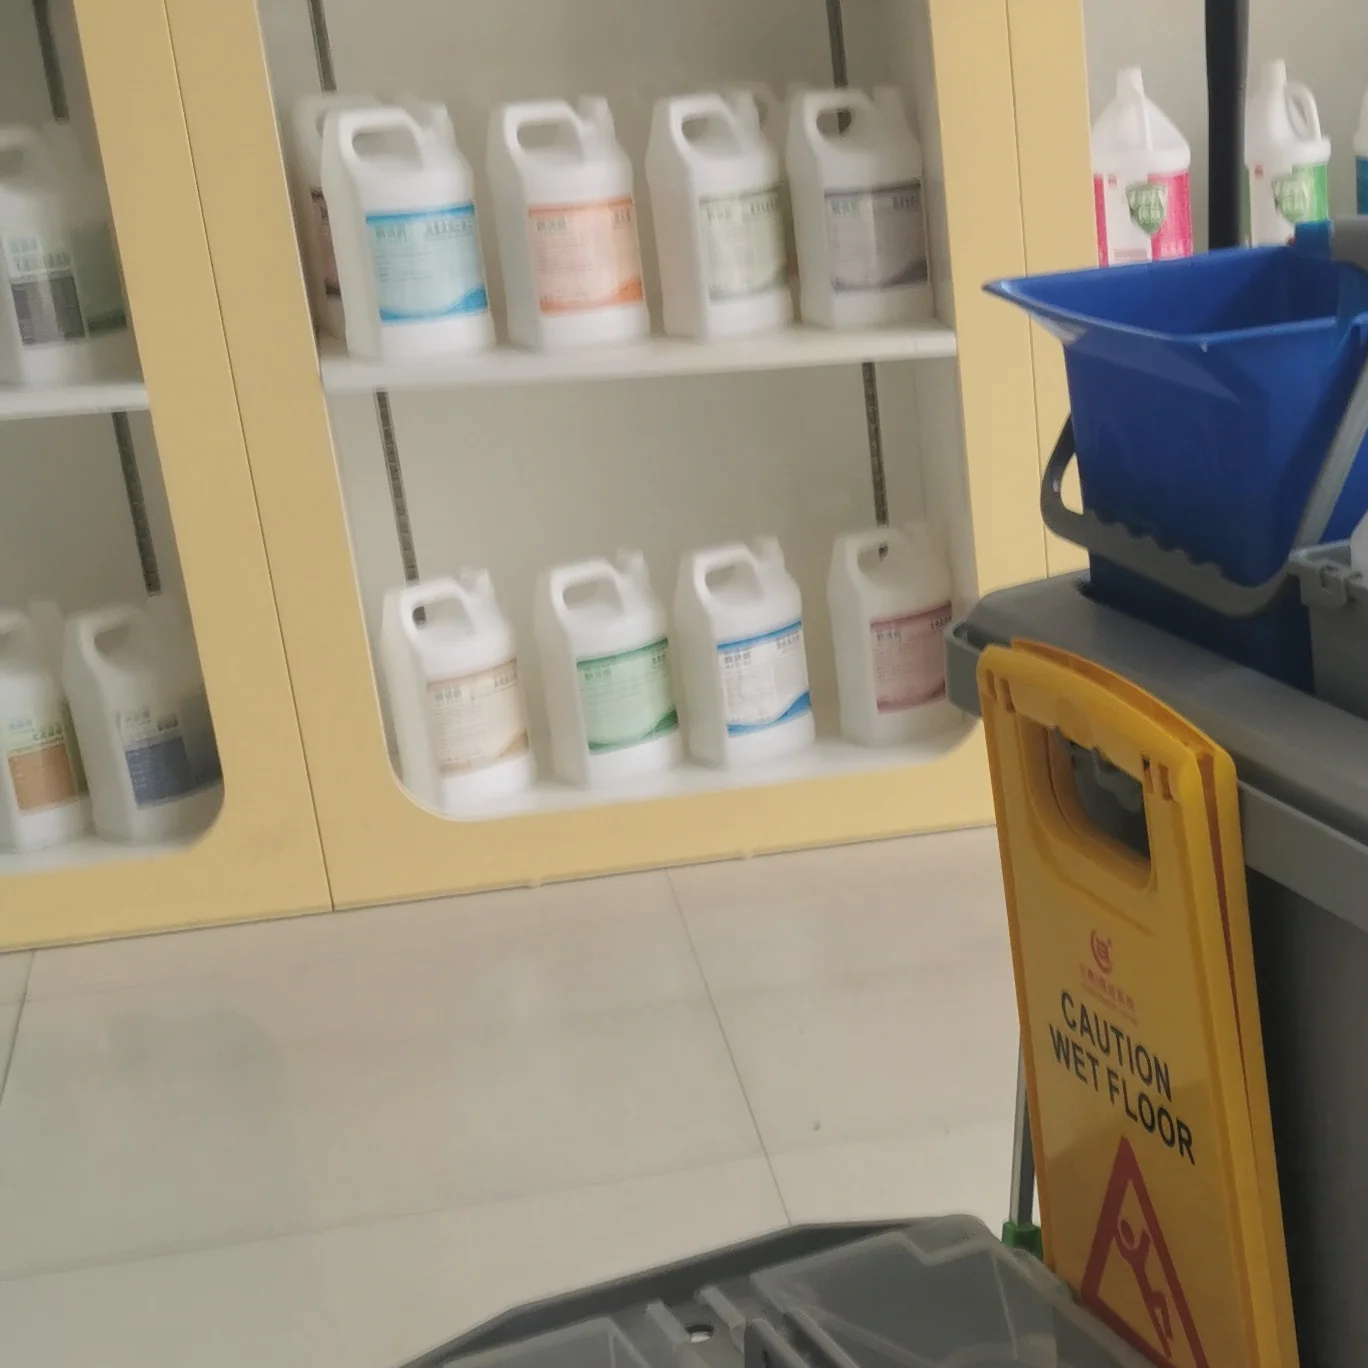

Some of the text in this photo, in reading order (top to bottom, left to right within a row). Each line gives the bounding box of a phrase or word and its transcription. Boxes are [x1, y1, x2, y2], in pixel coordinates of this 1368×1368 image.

[1048, 1022, 1196, 1167] WET FLOOR
[1060, 989, 1172, 1102] CAUTION
